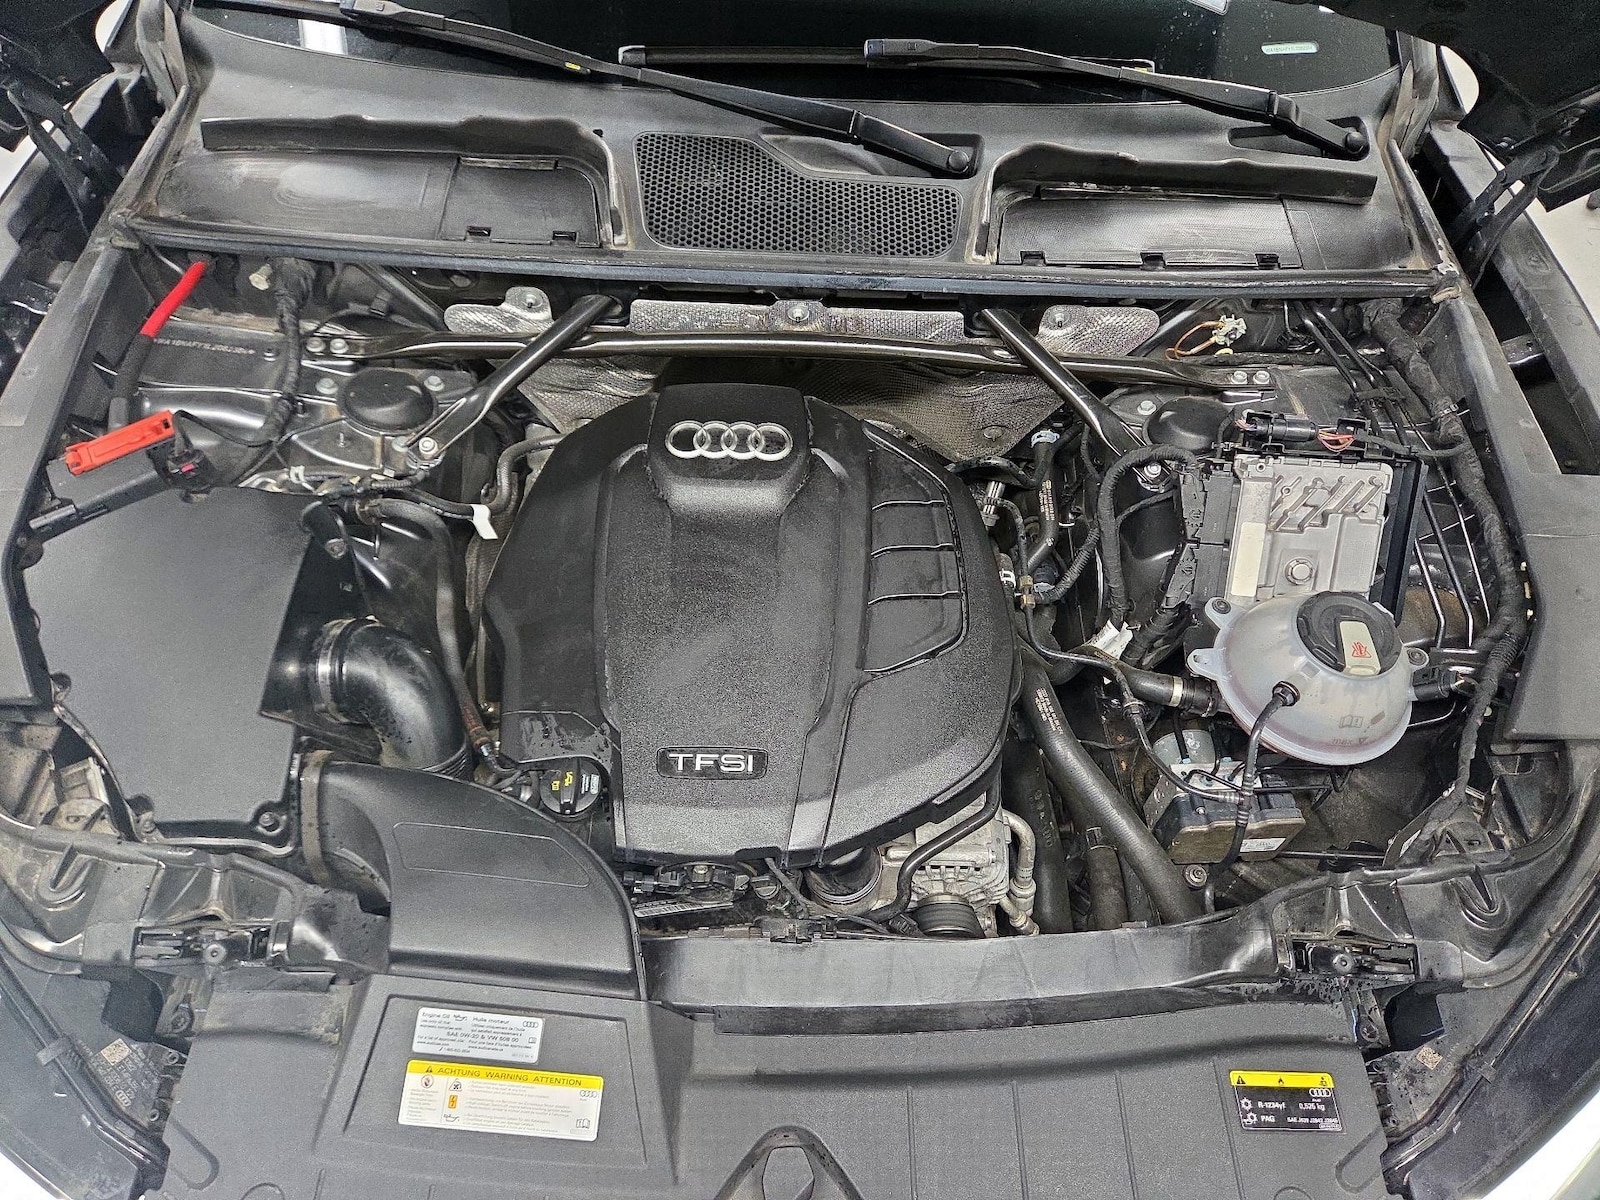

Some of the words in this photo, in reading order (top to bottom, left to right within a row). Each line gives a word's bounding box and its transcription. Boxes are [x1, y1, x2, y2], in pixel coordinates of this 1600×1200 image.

[668, 753, 754, 772] TFSI
[437, 1067, 481, 1077] ACHTUNG
[485, 1071, 529, 1082] WARNING
[533, 1076, 582, 1086] ATTENTION
[1257, 1101, 1286, 1110] R-1234yf
[1317, 1102, 1326, 1111] kg
[1260, 1115, 1276, 1123] PAG
